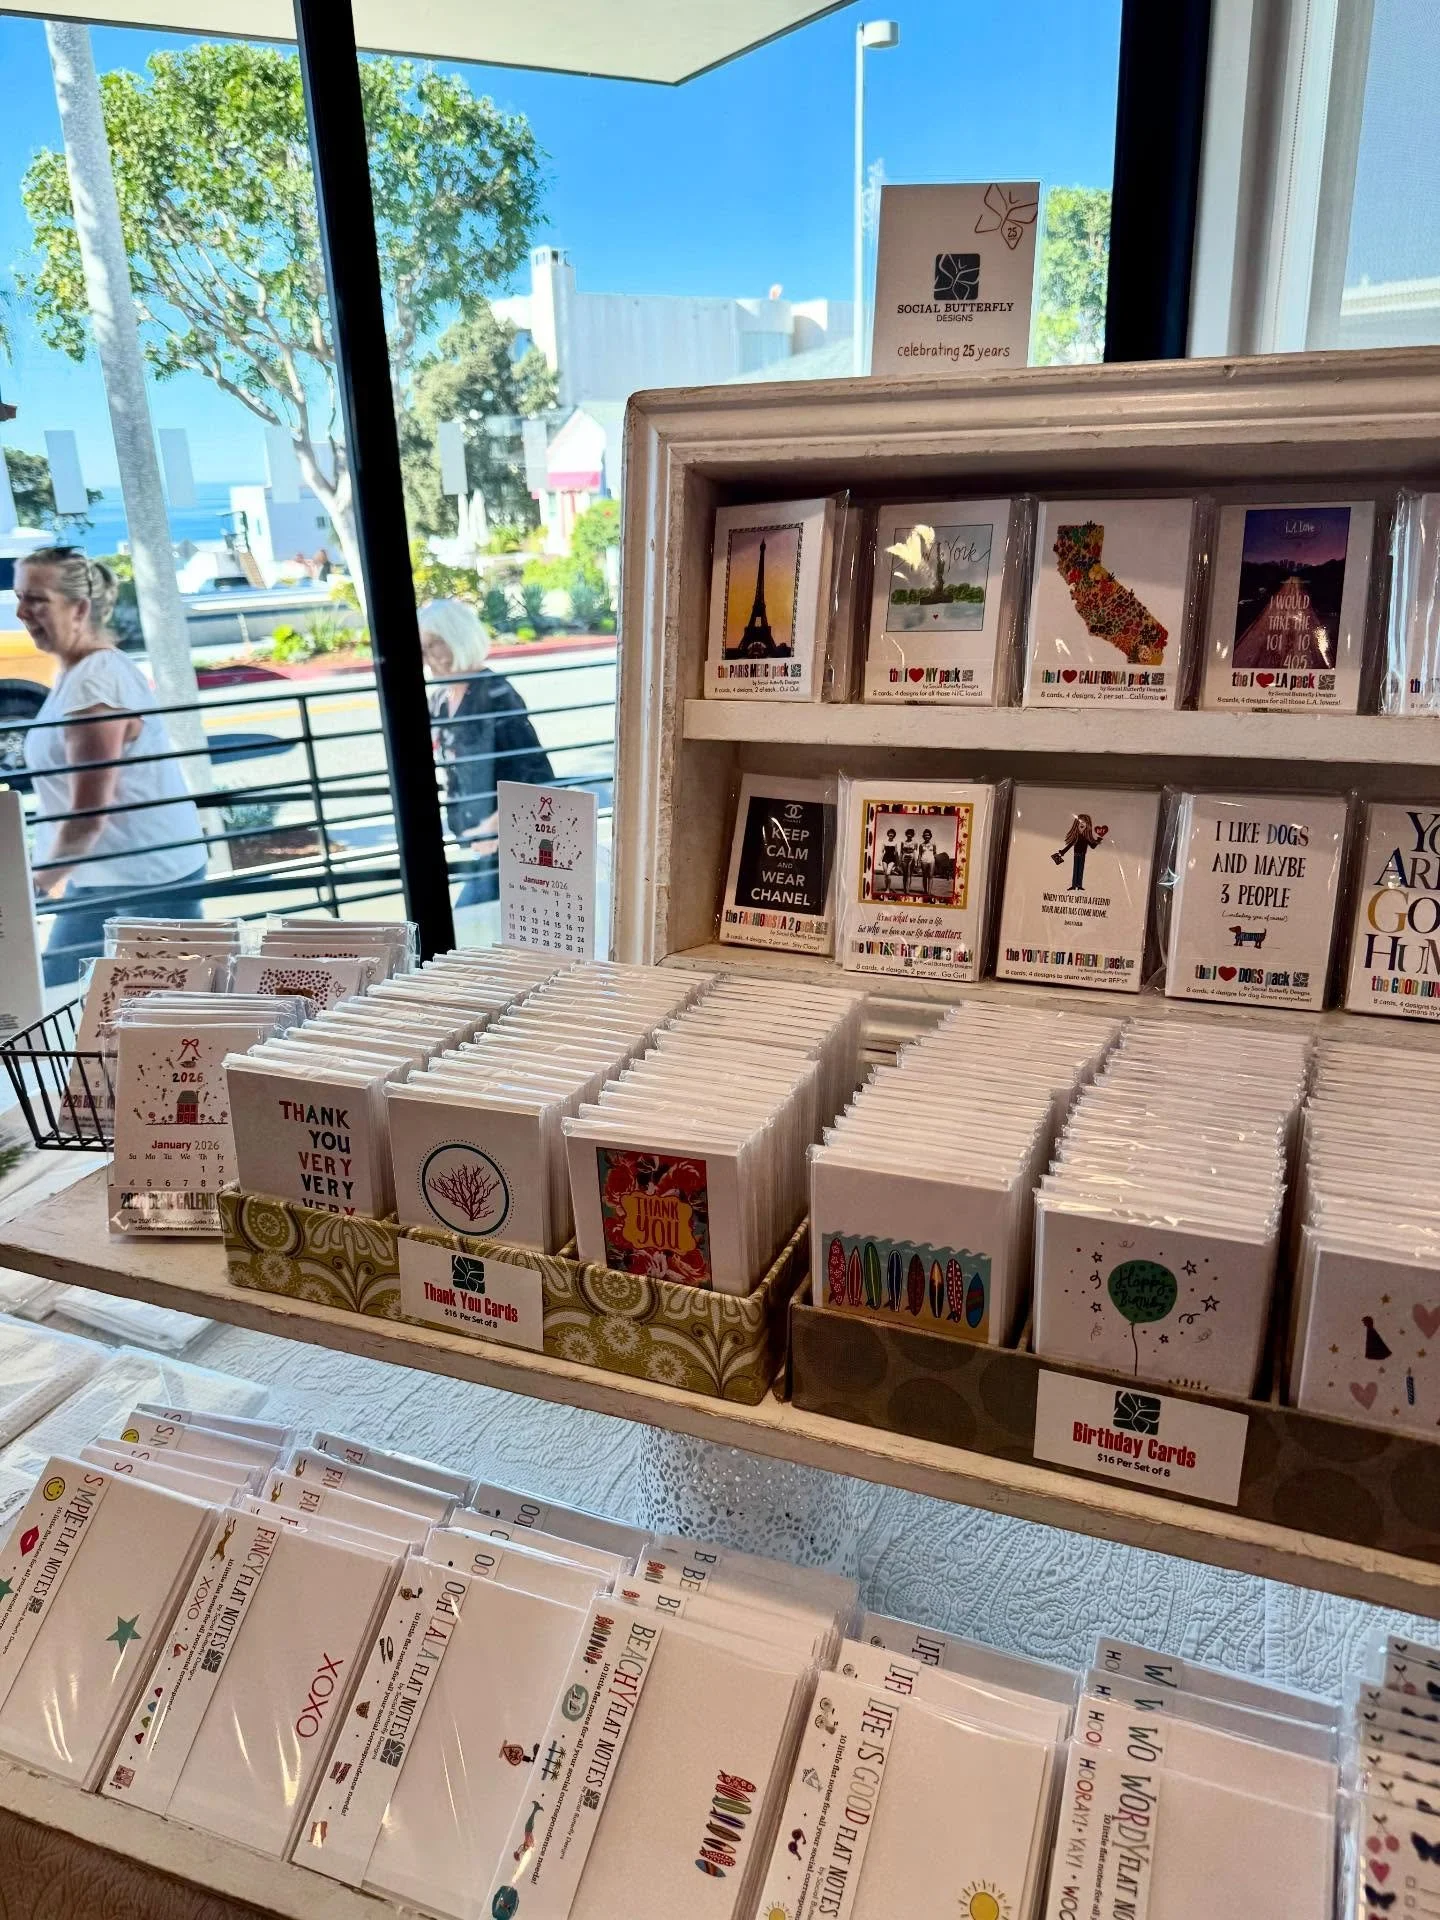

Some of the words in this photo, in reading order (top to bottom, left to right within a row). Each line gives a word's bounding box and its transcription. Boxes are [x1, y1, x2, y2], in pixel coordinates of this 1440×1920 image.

[1007, 227, 1018, 238] 25
[897, 304, 941, 314] SOCIAL
[945, 302, 1014, 313] BUTTERFLY
[936, 314, 973, 322] DESIGNS
[897, 343, 960, 361] celebrating
[963, 345, 975, 357] 25
[977, 345, 1010, 361] years
[1276, 595, 1310, 610] WOULD
[1269, 616, 1290, 630] TAKE
[1267, 635, 1282, 650] 101
[1299, 635, 1310, 650] 10
[718, 664, 728, 678] the
[772, 663, 789, 679] pack
[1284, 655, 1307, 669] 405
[926, 668, 938, 682] NY
[939, 668, 960, 684] pack
[1042, 670, 1056, 683] the
[1078, 671, 1126, 685] CALIFORNIA
[1127, 672, 1150, 687] pack
[1232, 672, 1247, 687] the
[1275, 673, 1287, 688] LA
[1290, 672, 1315, 690] pack
[535, 823, 556, 834] 2026
[771, 827, 810, 841] KEEP
[1215, 821, 1222, 842] I
[1228, 821, 1261, 844] LIKE
[1266, 823, 1309, 847] DOGS
[766, 845, 809, 861] CALM
[1212, 853, 1247, 874] AND
[1254, 854, 1307, 879] MAYBE
[1373, 847, 1440, 891] AR
[523, 875, 550, 888] January
[551, 880, 568, 890] 2026
[761, 871, 806, 887] WEAR
[750, 888, 810, 906] CHANEL
[1221, 883, 1230, 904] 3
[1237, 884, 1290, 908] PEOPLE
[725, 910, 738, 923] the
[788, 917, 795, 931] 2
[795, 920, 814, 933] pack
[1006, 948, 1019, 962] the
[1022, 949, 1049, 964] YOU'VE
[1050, 951, 1066, 965] GOT
[1067, 952, 1073, 965] A
[1075, 953, 1104, 967] FRIEND
[1104, 955, 1126, 970] pack
[1195, 965, 1211, 980] the
[1238, 967, 1264, 984] DOGS
[1265, 971, 1290, 990] pack
[1371, 976, 1389, 992] the
[1391, 977, 1418, 995] GOOD
[172, 1072, 204, 1083] 2026
[278, 1101, 351, 1130] THANK
[152, 1140, 192, 1151] January
[195, 1140, 220, 1150] 2026
[308, 1130, 351, 1154] YOU
[298, 1151, 352, 1176] VERY
[201, 1179, 206, 1187] 8
[218, 1179, 224, 1187] 9
[301, 1174, 354, 1200] VERY
[176, 1192, 216, 1210] CALEND
[635, 1197, 679, 1220] THANK
[635, 1216, 680, 1249] YOU
[1115, 1264, 1172, 1297] Happy
[423, 1281, 456, 1307] Thank
[459, 1291, 482, 1313] You
[484, 1297, 518, 1323] Cards
[444, 1308, 457, 1318] $16
[460, 1312, 471, 1321] Per
[1072, 1421, 1144, 1459] Birthday
[1147, 1438, 1196, 1469] Cards
[1097, 1453, 1115, 1464] $16
[1117, 1457, 1132, 1468] Per
[1134, 1462, 1150, 1473] Set
[1151, 1467, 1163, 1476] of
[1163, 1469, 1171, 1477] 8
[53, 1527, 78, 1556] FLAT
[239, 1526, 276, 1576] FANCY
[33, 1556, 63, 1596] NOTES
[187, 1576, 214, 1620] XOXO
[230, 1573, 255, 1606] FLAT
[435, 1581, 466, 1616] OOH
[211, 1603, 240, 1650] NOTES
[608, 1622, 657, 1709] BEACHY
[408, 1661, 430, 1696] FLAT
[597, 1671, 607, 1690] little
[295, 1652, 344, 1739] XOXO
[592, 1690, 601, 1704] flat
[389, 1699, 416, 1741] NOTES
[585, 1704, 596, 1726] notes
[602, 1700, 628, 1739] FLAT
[860, 1696, 900, 1738] LIFE
[577, 1738, 585, 1749] all
[580, 1726, 589, 1738] for
[570, 1748, 581, 1767] your
[585, 1738, 616, 1787] NOTES
[857, 1740, 885, 1765] IS
[562, 1768, 574, 1792] social
[845, 1765, 880, 1825] GOOD
[1072, 1757, 1096, 1831] HOORAY!
[540, 1791, 566, 1856] correspondence
[1111, 1773, 1157, 1864] WORDY
[832, 1824, 857, 1865] FLAT
[1065, 1837, 1087, 1875] YAY!
[530, 1856, 544, 1884] needs!
[1116, 1853, 1141, 1898] FLAT
[818, 1865, 848, 1918] NOTES
